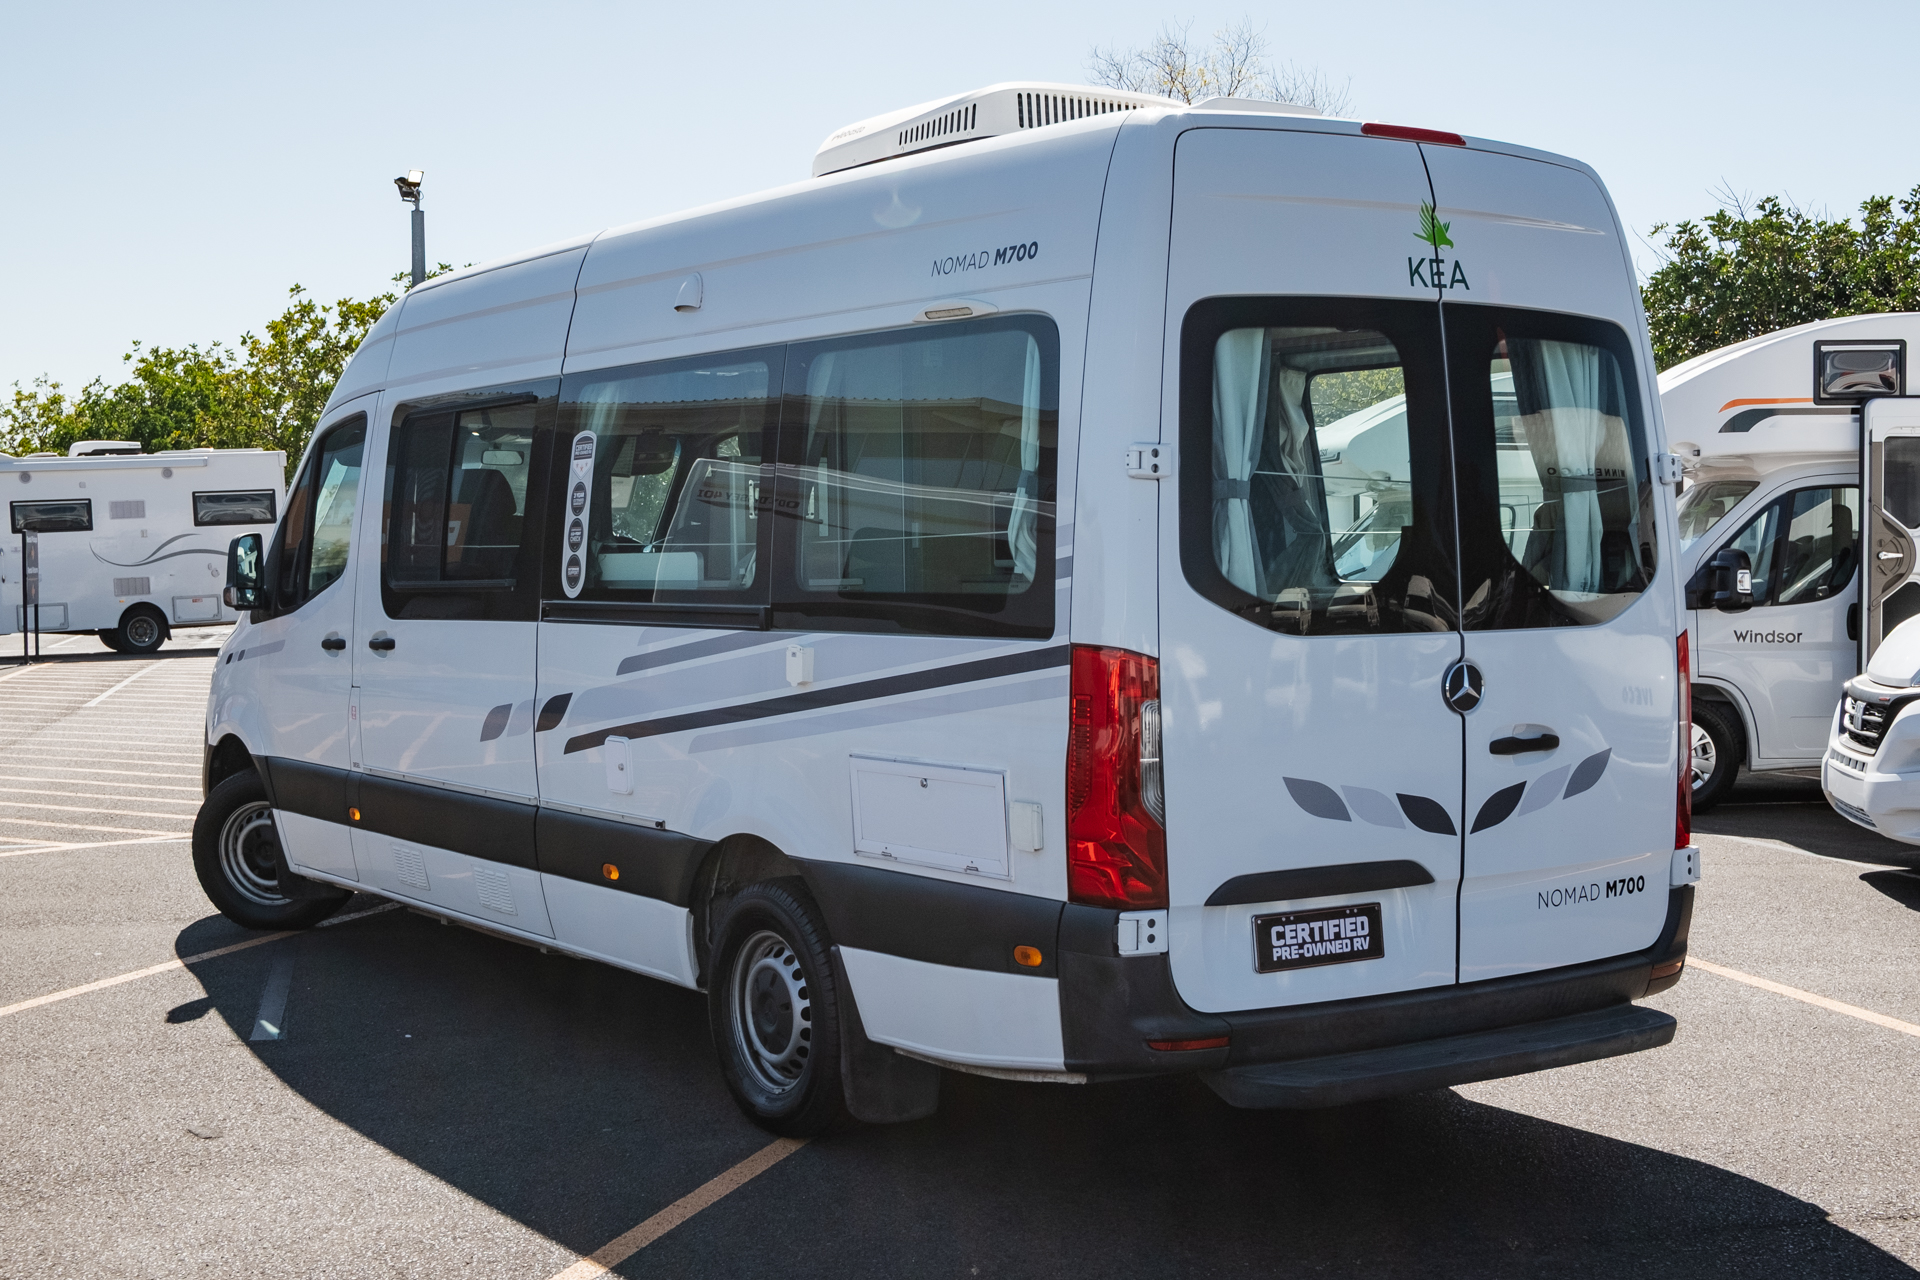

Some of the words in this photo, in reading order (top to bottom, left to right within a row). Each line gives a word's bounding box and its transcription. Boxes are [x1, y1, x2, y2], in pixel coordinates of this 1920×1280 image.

[931, 251, 989, 277] NOMAD
[994, 241, 1038, 266] M700
[1408, 256, 1470, 290] KEA
[1733, 630, 1803, 643] Windsor
[1538, 883, 1600, 909] NOMAD
[1606, 875, 1645, 898] M700
[1271, 915, 1369, 947] CERTIFIED
[1273, 939, 1351, 961] PRE-OWNED
[1353, 936, 1370, 951] RV
